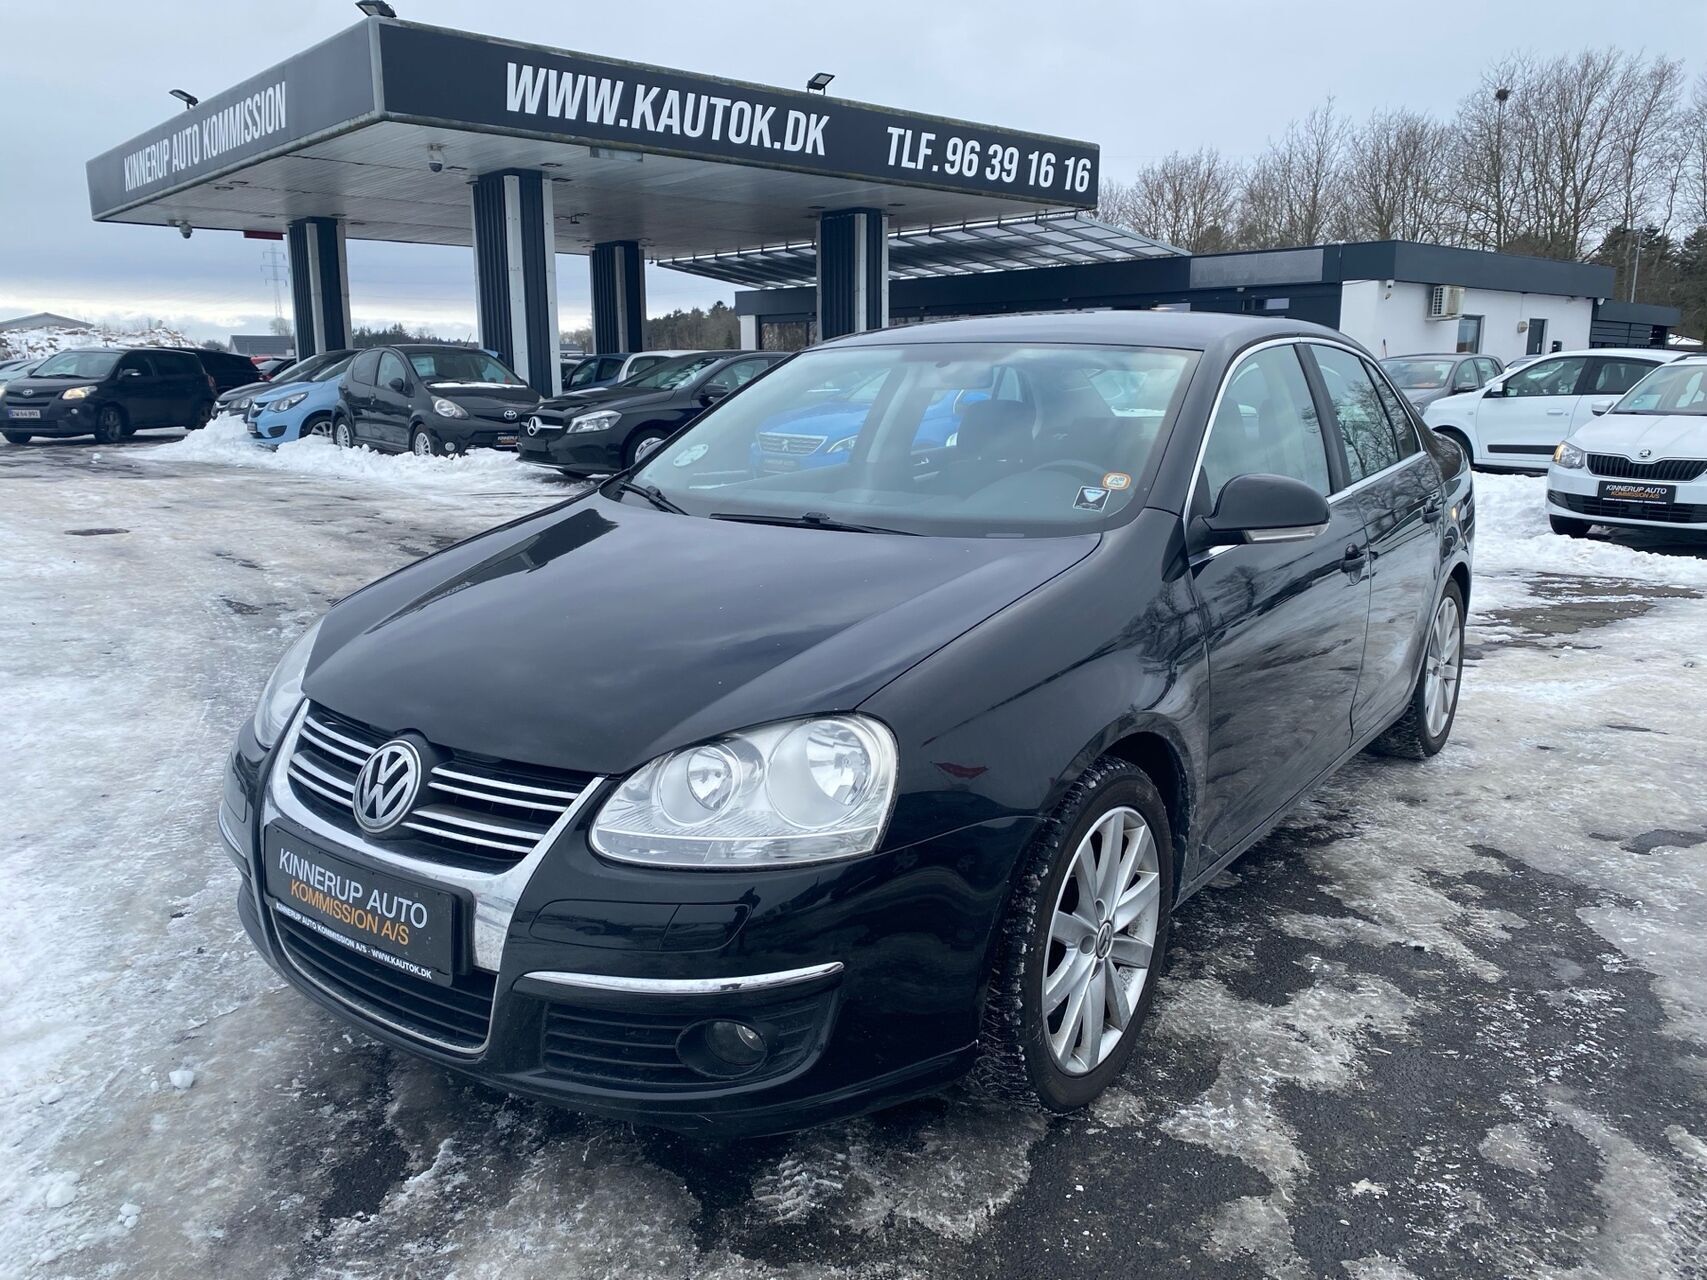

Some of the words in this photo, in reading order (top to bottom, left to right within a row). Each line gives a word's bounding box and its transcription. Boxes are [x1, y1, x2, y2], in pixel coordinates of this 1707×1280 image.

[124, 138, 169, 192] KINNERUP
[172, 124, 199, 173] AUTO
[203, 81, 286, 161] KOMMISSION
[507, 62, 830, 156] WWW.KAUTOK.DK
[887, 126, 939, 172] TLF.
[944, 137, 980, 177] 96
[985, 144, 1019, 183] 39
[1028, 151, 1056, 188] 16
[1064, 156, 1091, 193] 16
[1605, 484, 1644, 493] KINNERUP
[279, 848, 363, 904] KINNERUP
[366, 889, 428, 929] AUTO
[290, 879, 379, 934] KOMMISSION
[381, 920, 409, 945] A/S
[276, 901, 301, 921] KINNERUP
[302, 916, 317, 930] AUTO
[317, 924, 355, 948] KOMMISSION
